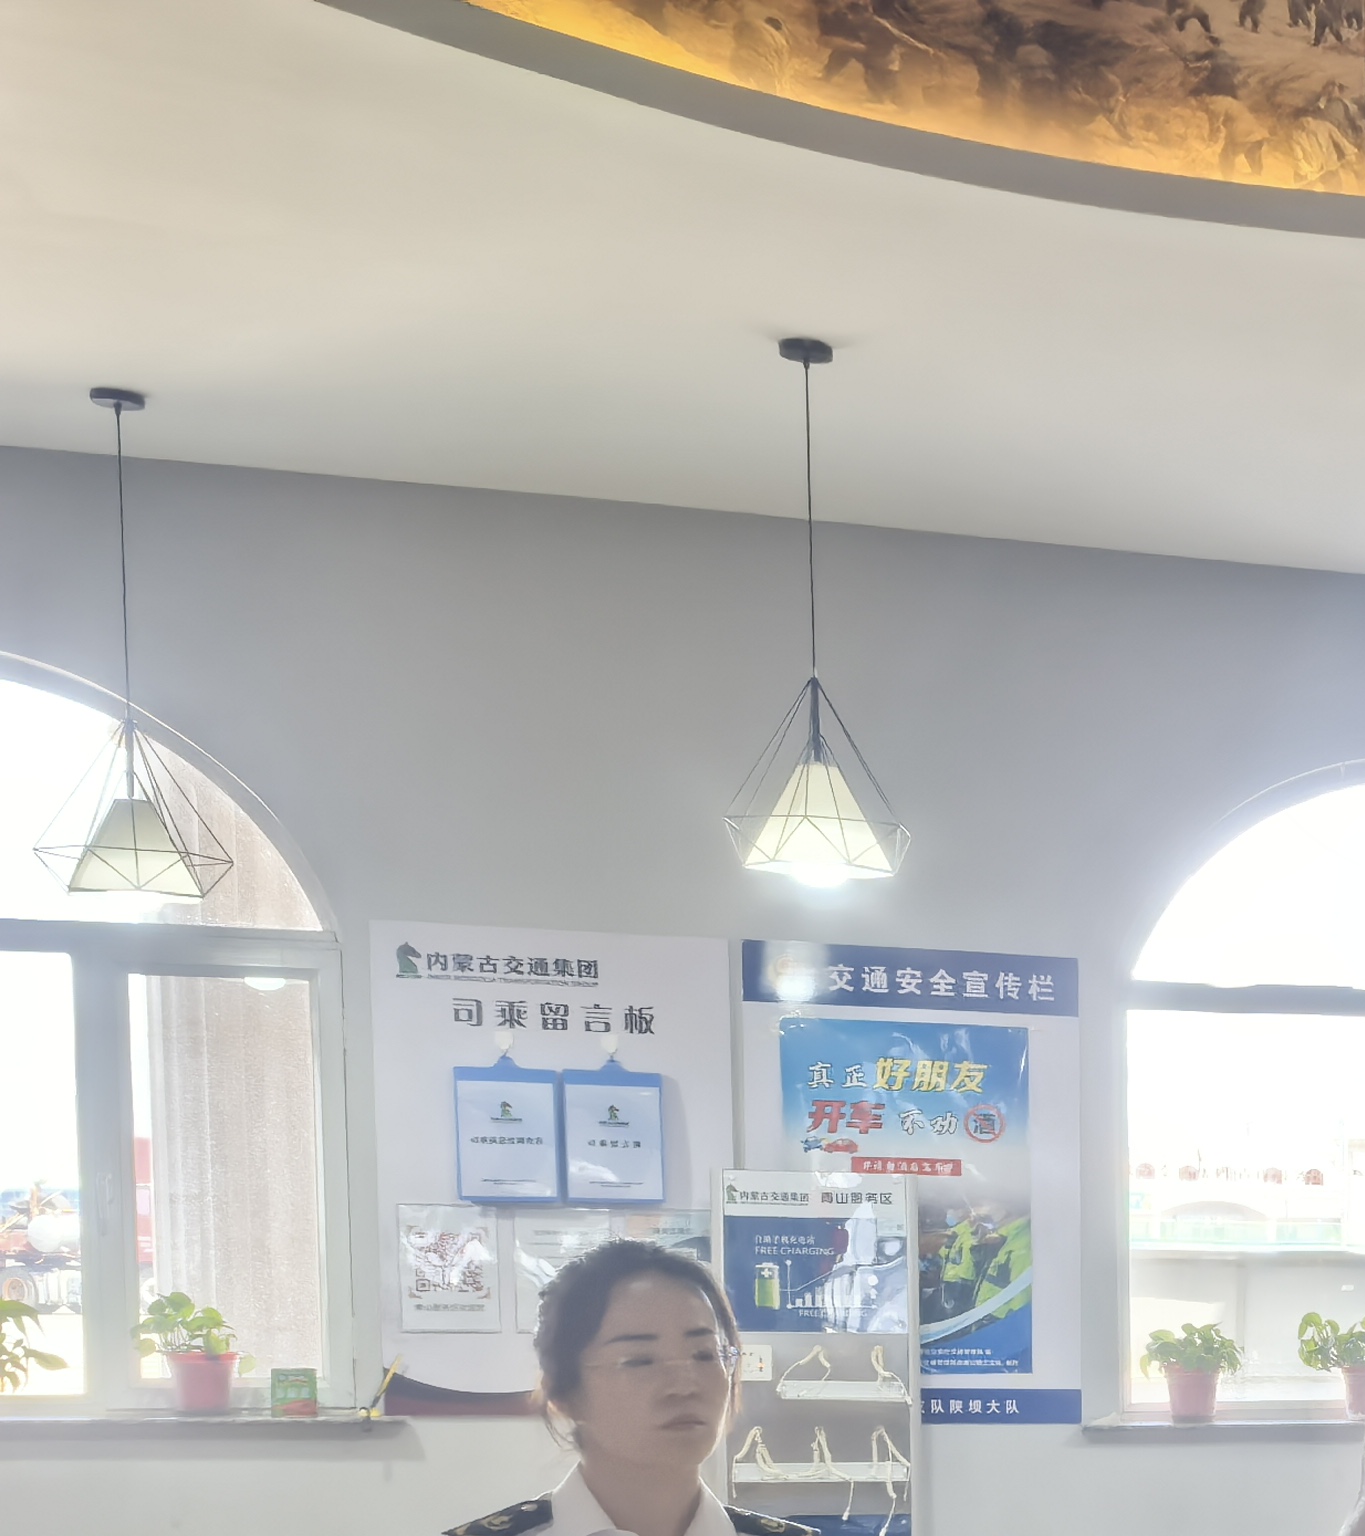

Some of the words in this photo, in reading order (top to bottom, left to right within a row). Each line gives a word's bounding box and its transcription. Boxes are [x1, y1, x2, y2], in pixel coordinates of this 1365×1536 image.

[426, 951, 599, 979] 内蒙古交通集团
[828, 964, 1055, 1002] 交通安全宣传栏
[452, 998, 655, 1035] 司乘留言板
[807, 1057, 990, 1094] 真正好朋友
[755, 1246, 778, 1255] FREE
[780, 1247, 835, 1256] CHARGING
